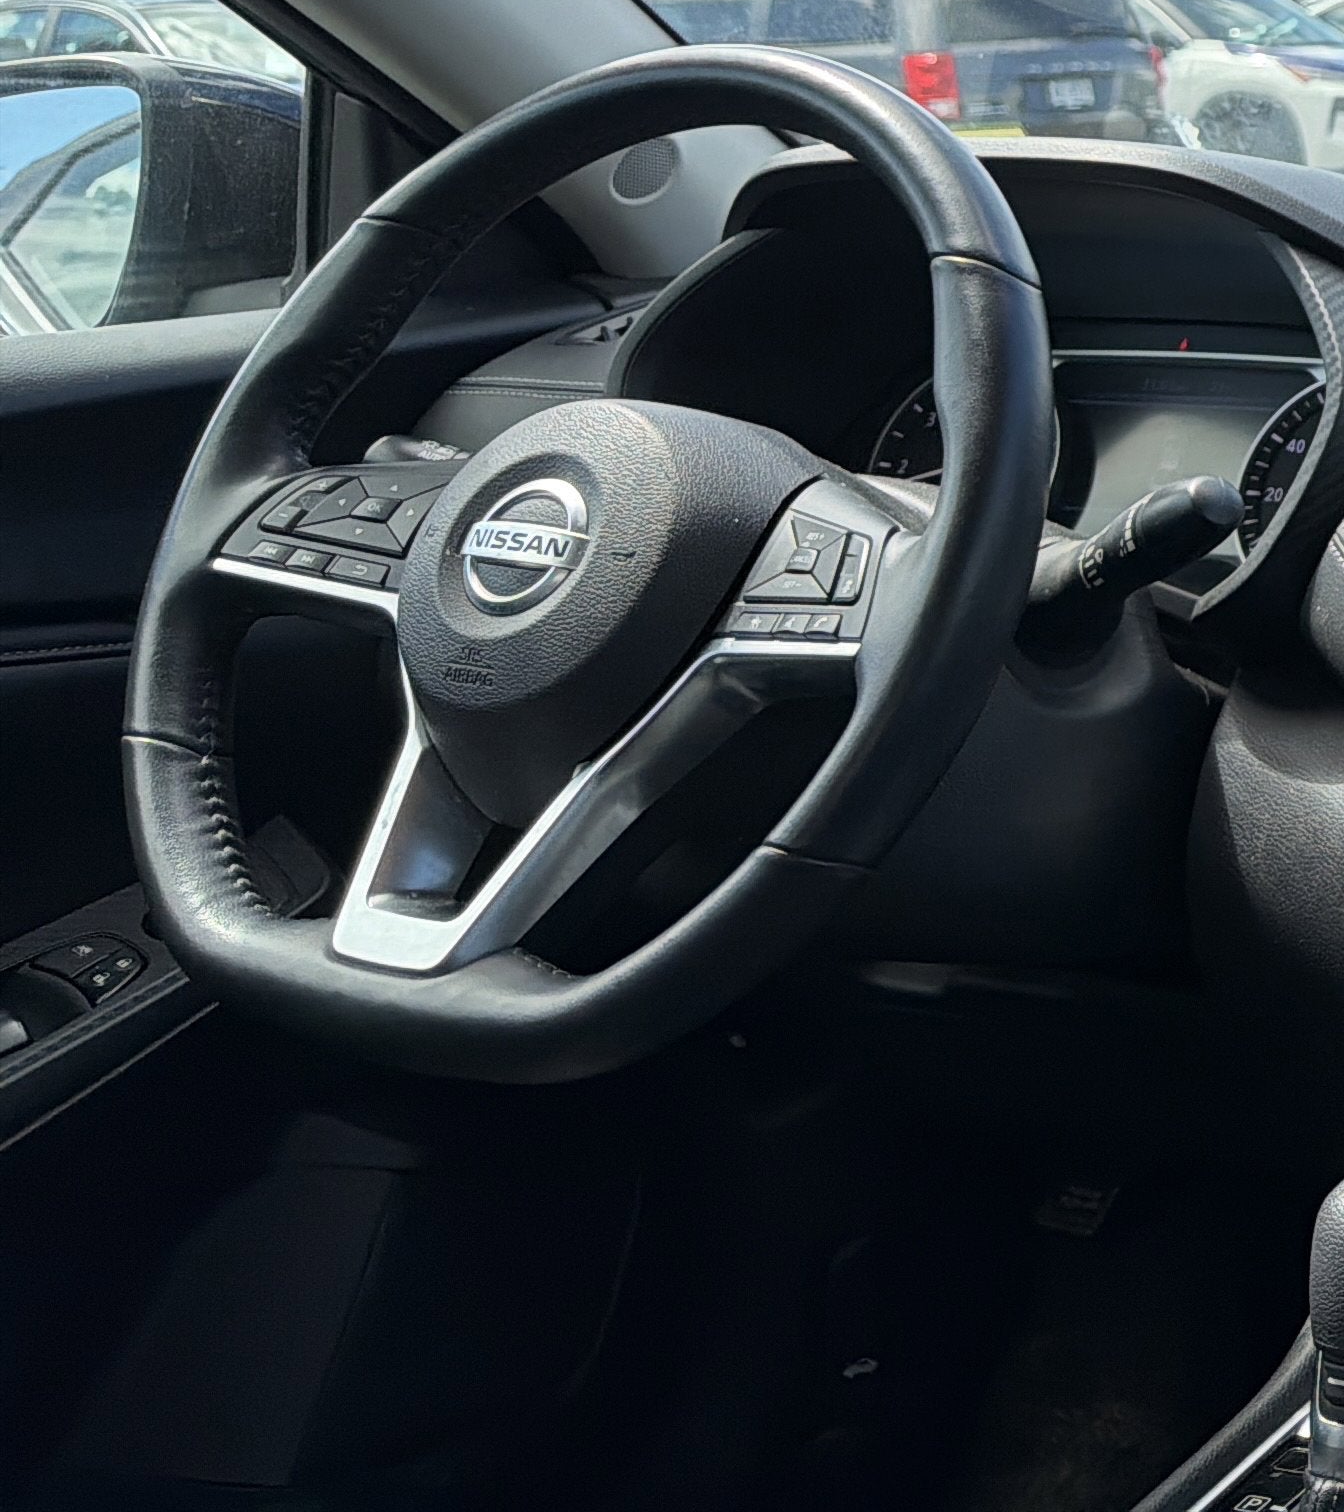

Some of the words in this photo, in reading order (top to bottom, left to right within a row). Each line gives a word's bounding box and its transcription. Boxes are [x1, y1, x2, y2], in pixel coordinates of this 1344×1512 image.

[1285, 438, 1306, 454] 40
[1263, 487, 1284, 502] 20
[367, 502, 383, 514] OK
[468, 528, 571, 558] NISSAN
[1244, 1498, 1264, 1510] P
